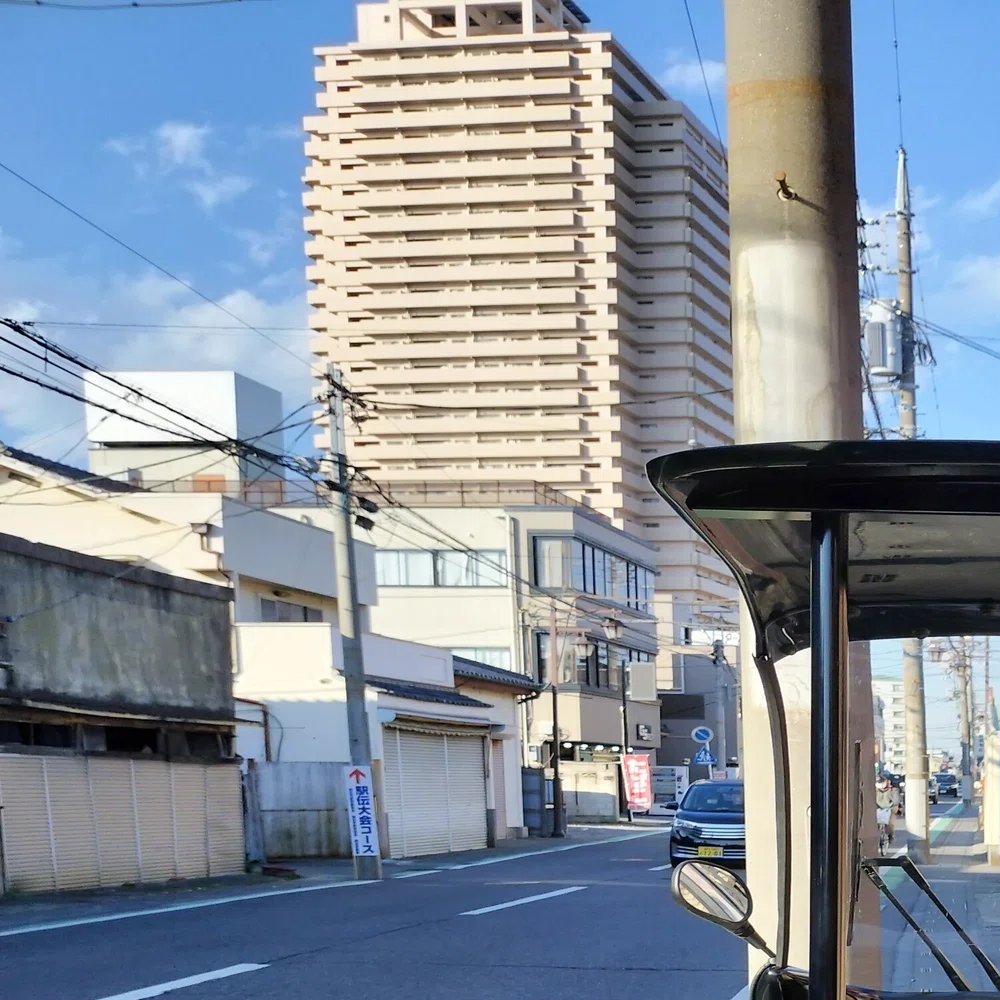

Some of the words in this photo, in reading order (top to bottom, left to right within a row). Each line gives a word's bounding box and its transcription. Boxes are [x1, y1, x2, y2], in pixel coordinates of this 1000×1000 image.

[355, 785, 374, 854] 駅伝大会コース
